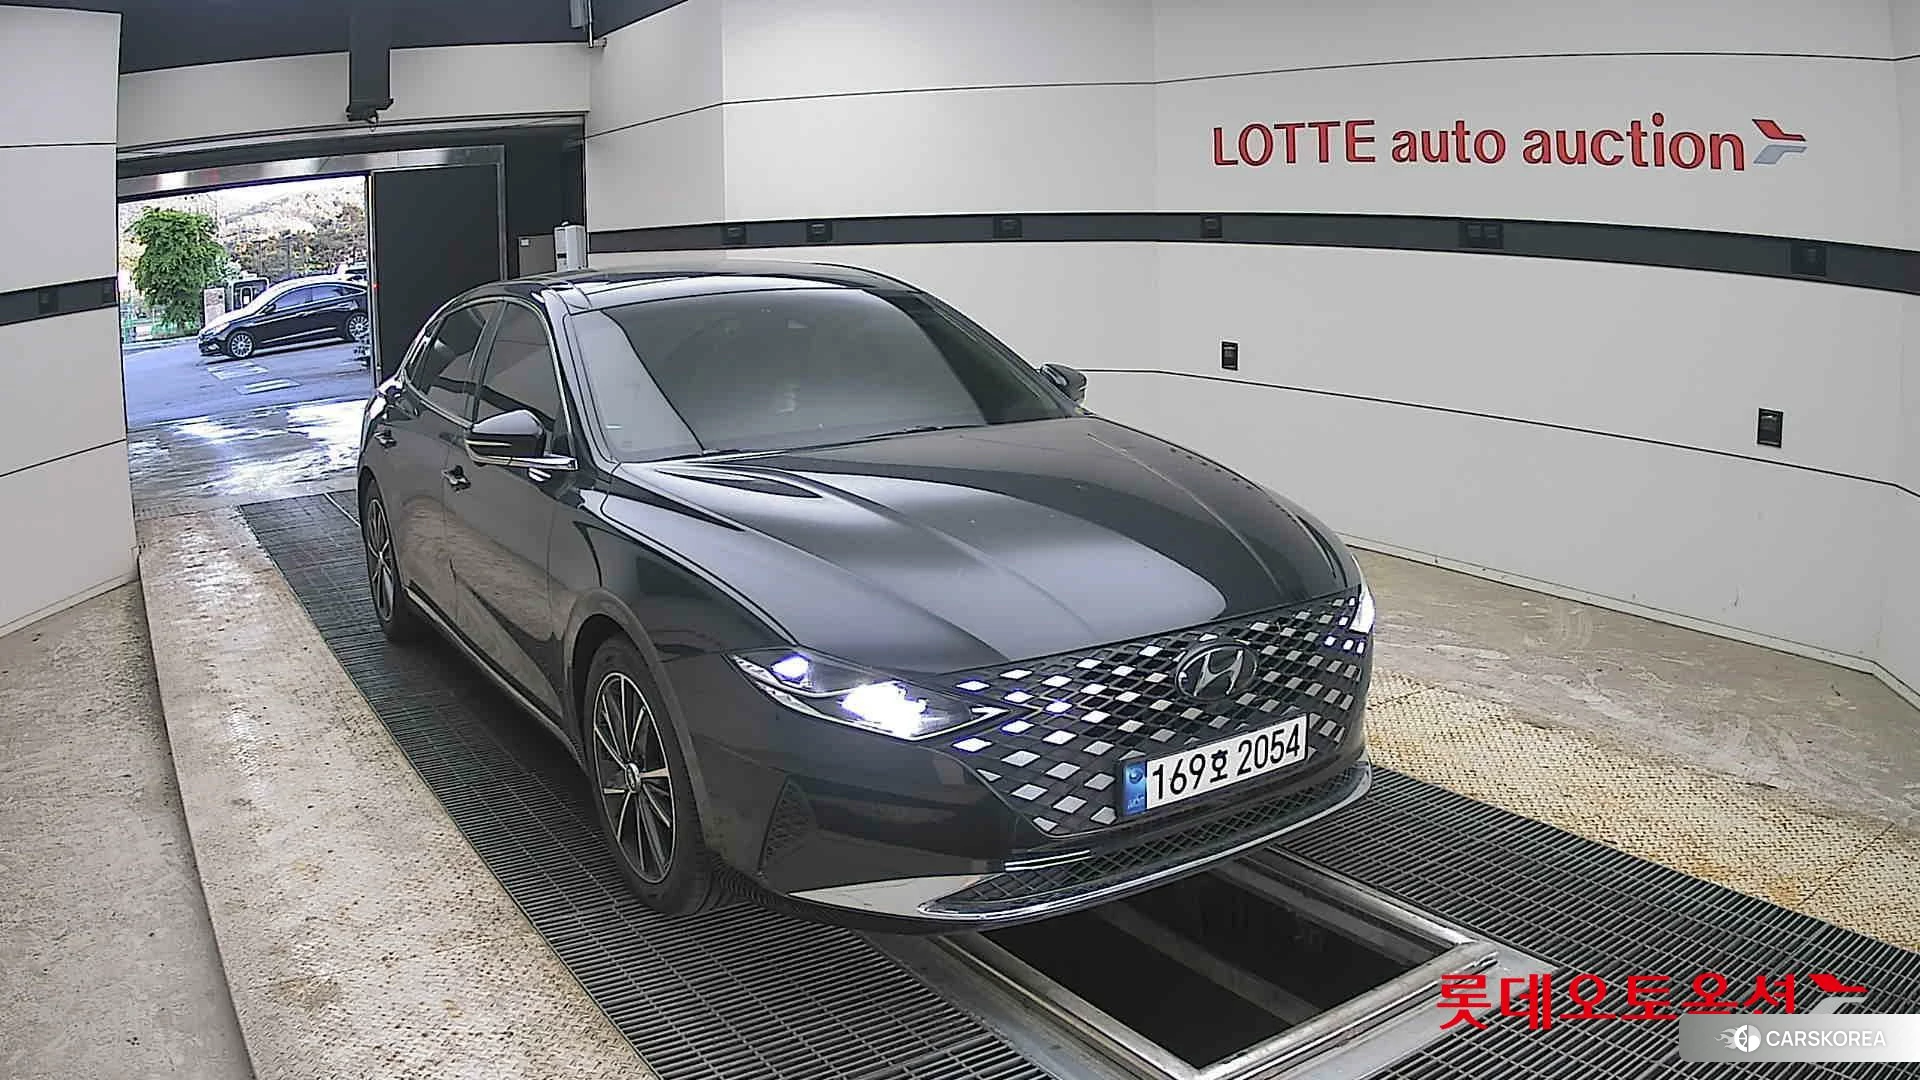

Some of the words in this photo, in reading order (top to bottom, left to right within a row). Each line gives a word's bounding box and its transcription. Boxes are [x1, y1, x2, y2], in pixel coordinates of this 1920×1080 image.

[1212, 119, 1376, 167] LOTTE
[1392, 120, 1507, 164] auto
[1522, 113, 1746, 172] auction
[1151, 749, 1229, 800] 169호
[1236, 722, 1301, 777] 2054
